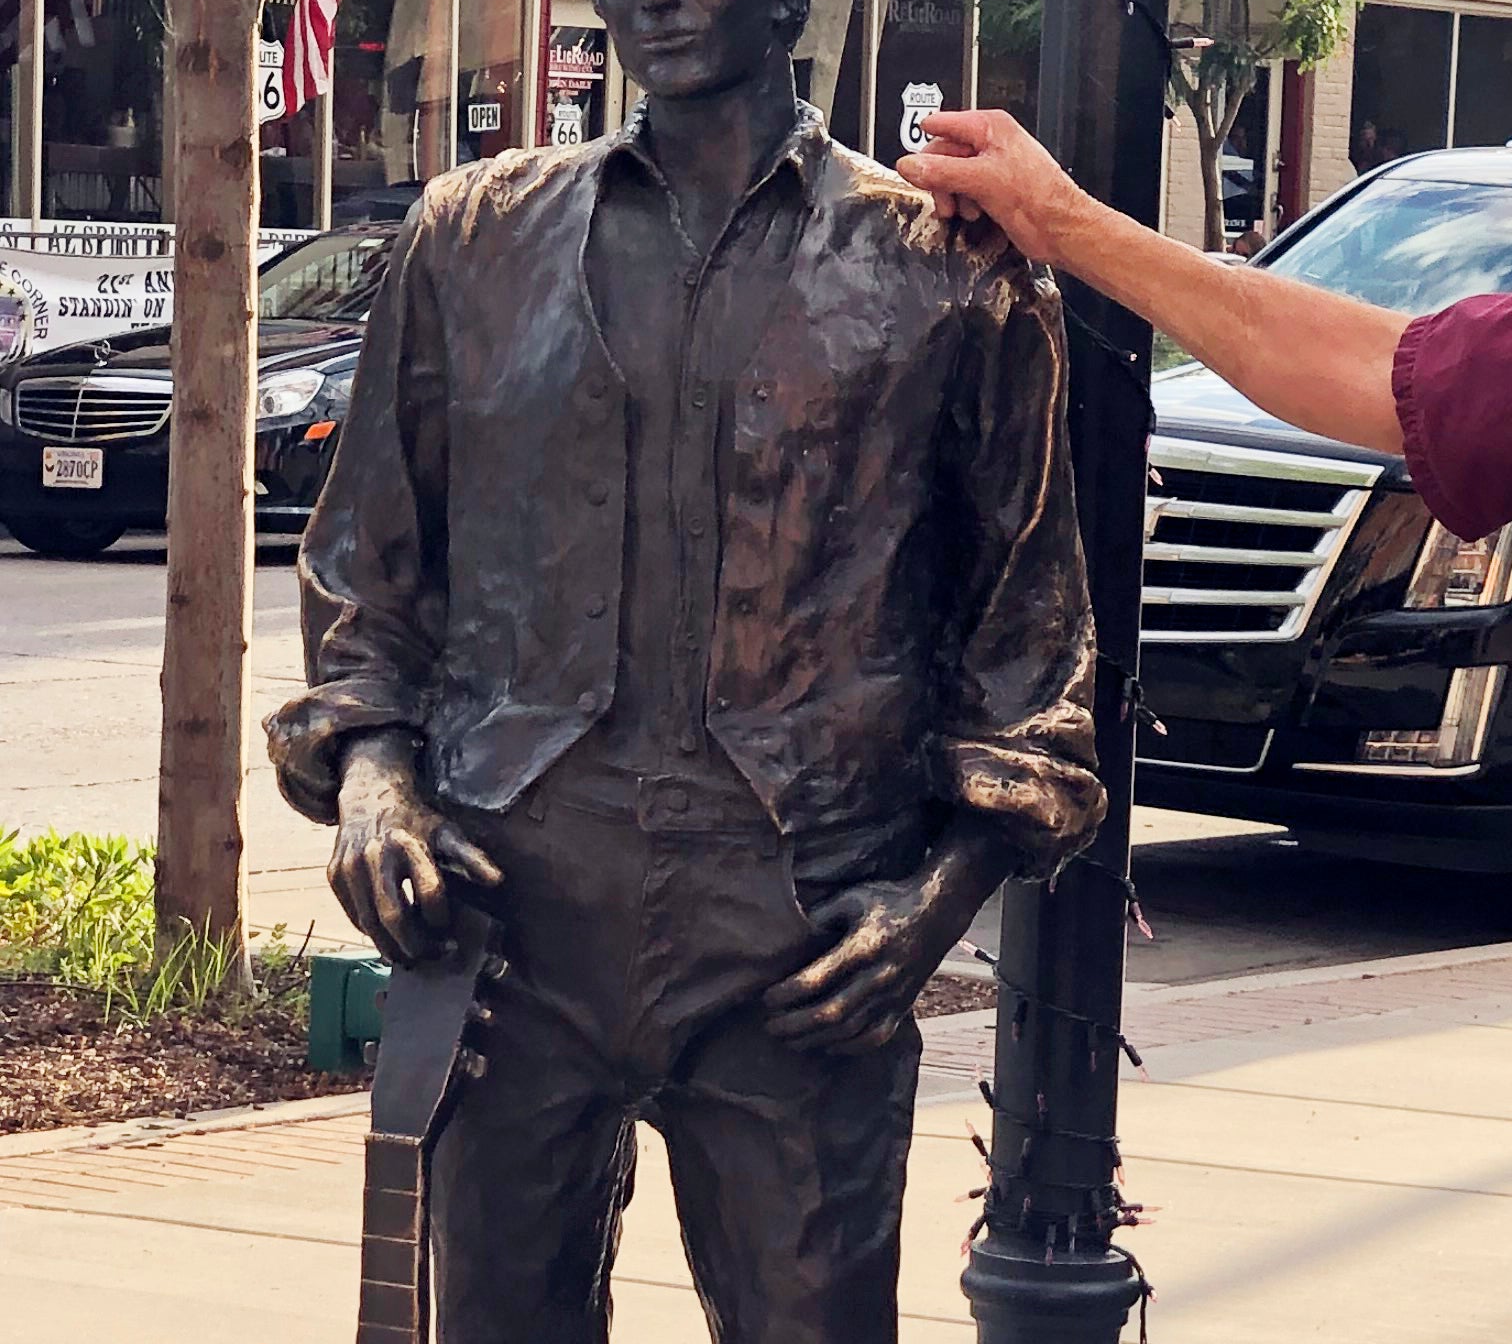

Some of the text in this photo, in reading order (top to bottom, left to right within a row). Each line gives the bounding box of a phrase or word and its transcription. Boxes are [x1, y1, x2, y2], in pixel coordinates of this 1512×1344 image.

[260, 52, 277, 63] UTE
[260, 71, 280, 109] 6
[569, 81, 592, 89] DAILY
[910, 93, 935, 103] ROUTE
[471, 106, 498, 128] OPEN
[558, 123, 578, 144] 66
[11, 269, 49, 340] CORNER
[144, 297, 165, 318] ON
